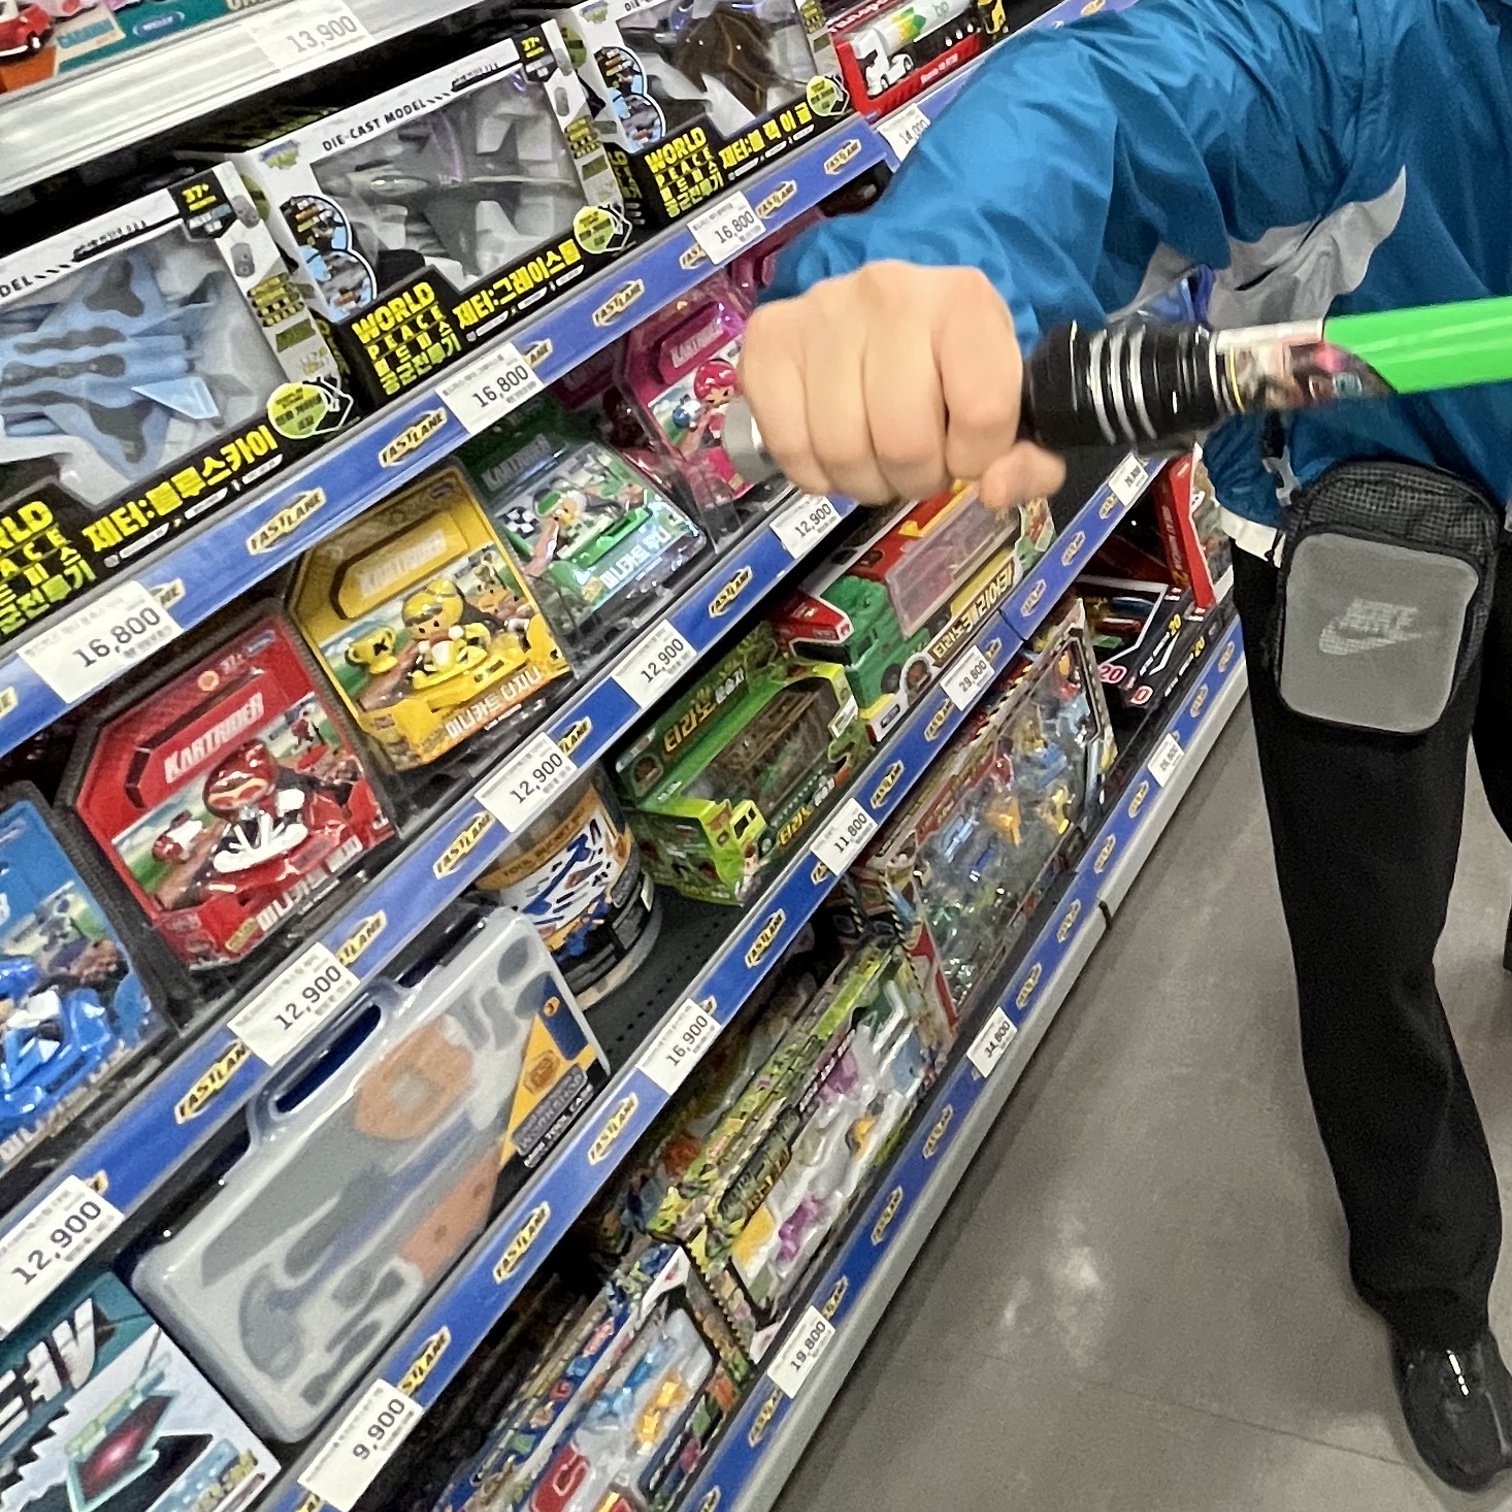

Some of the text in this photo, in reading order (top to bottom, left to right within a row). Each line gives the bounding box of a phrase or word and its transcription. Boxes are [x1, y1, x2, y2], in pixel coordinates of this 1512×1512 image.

[288, 16, 358, 53] 13,900
[932, 0, 950, 20] bp
[321, 98, 427, 152] DIE-CAST MODEL
[643, 125, 709, 175] WORLD
[654, 144, 715, 188] PEACE
[714, 210, 755, 244] 16,800
[351, 281, 435, 344] WORLD
[366, 304, 443, 361] PEACE
[471, 364, 529, 408] 16,800
[794, 503, 832, 538] 12,900
[72, 605, 162, 669] 16,800
[640, 637, 684, 684] 12,900
[663, 689, 718, 753] 티라노
[509, 752, 564, 805] 12,900
[833, 811, 868, 853] 11,800
[273, 964, 342, 1032] 12,900
[665, 1014, 709, 1068] 16,900
[10, 1200, 102, 1286] 12,900
[790, 1320, 826, 1372] 19,800
[352, 1397, 406, 1461] 9,900
